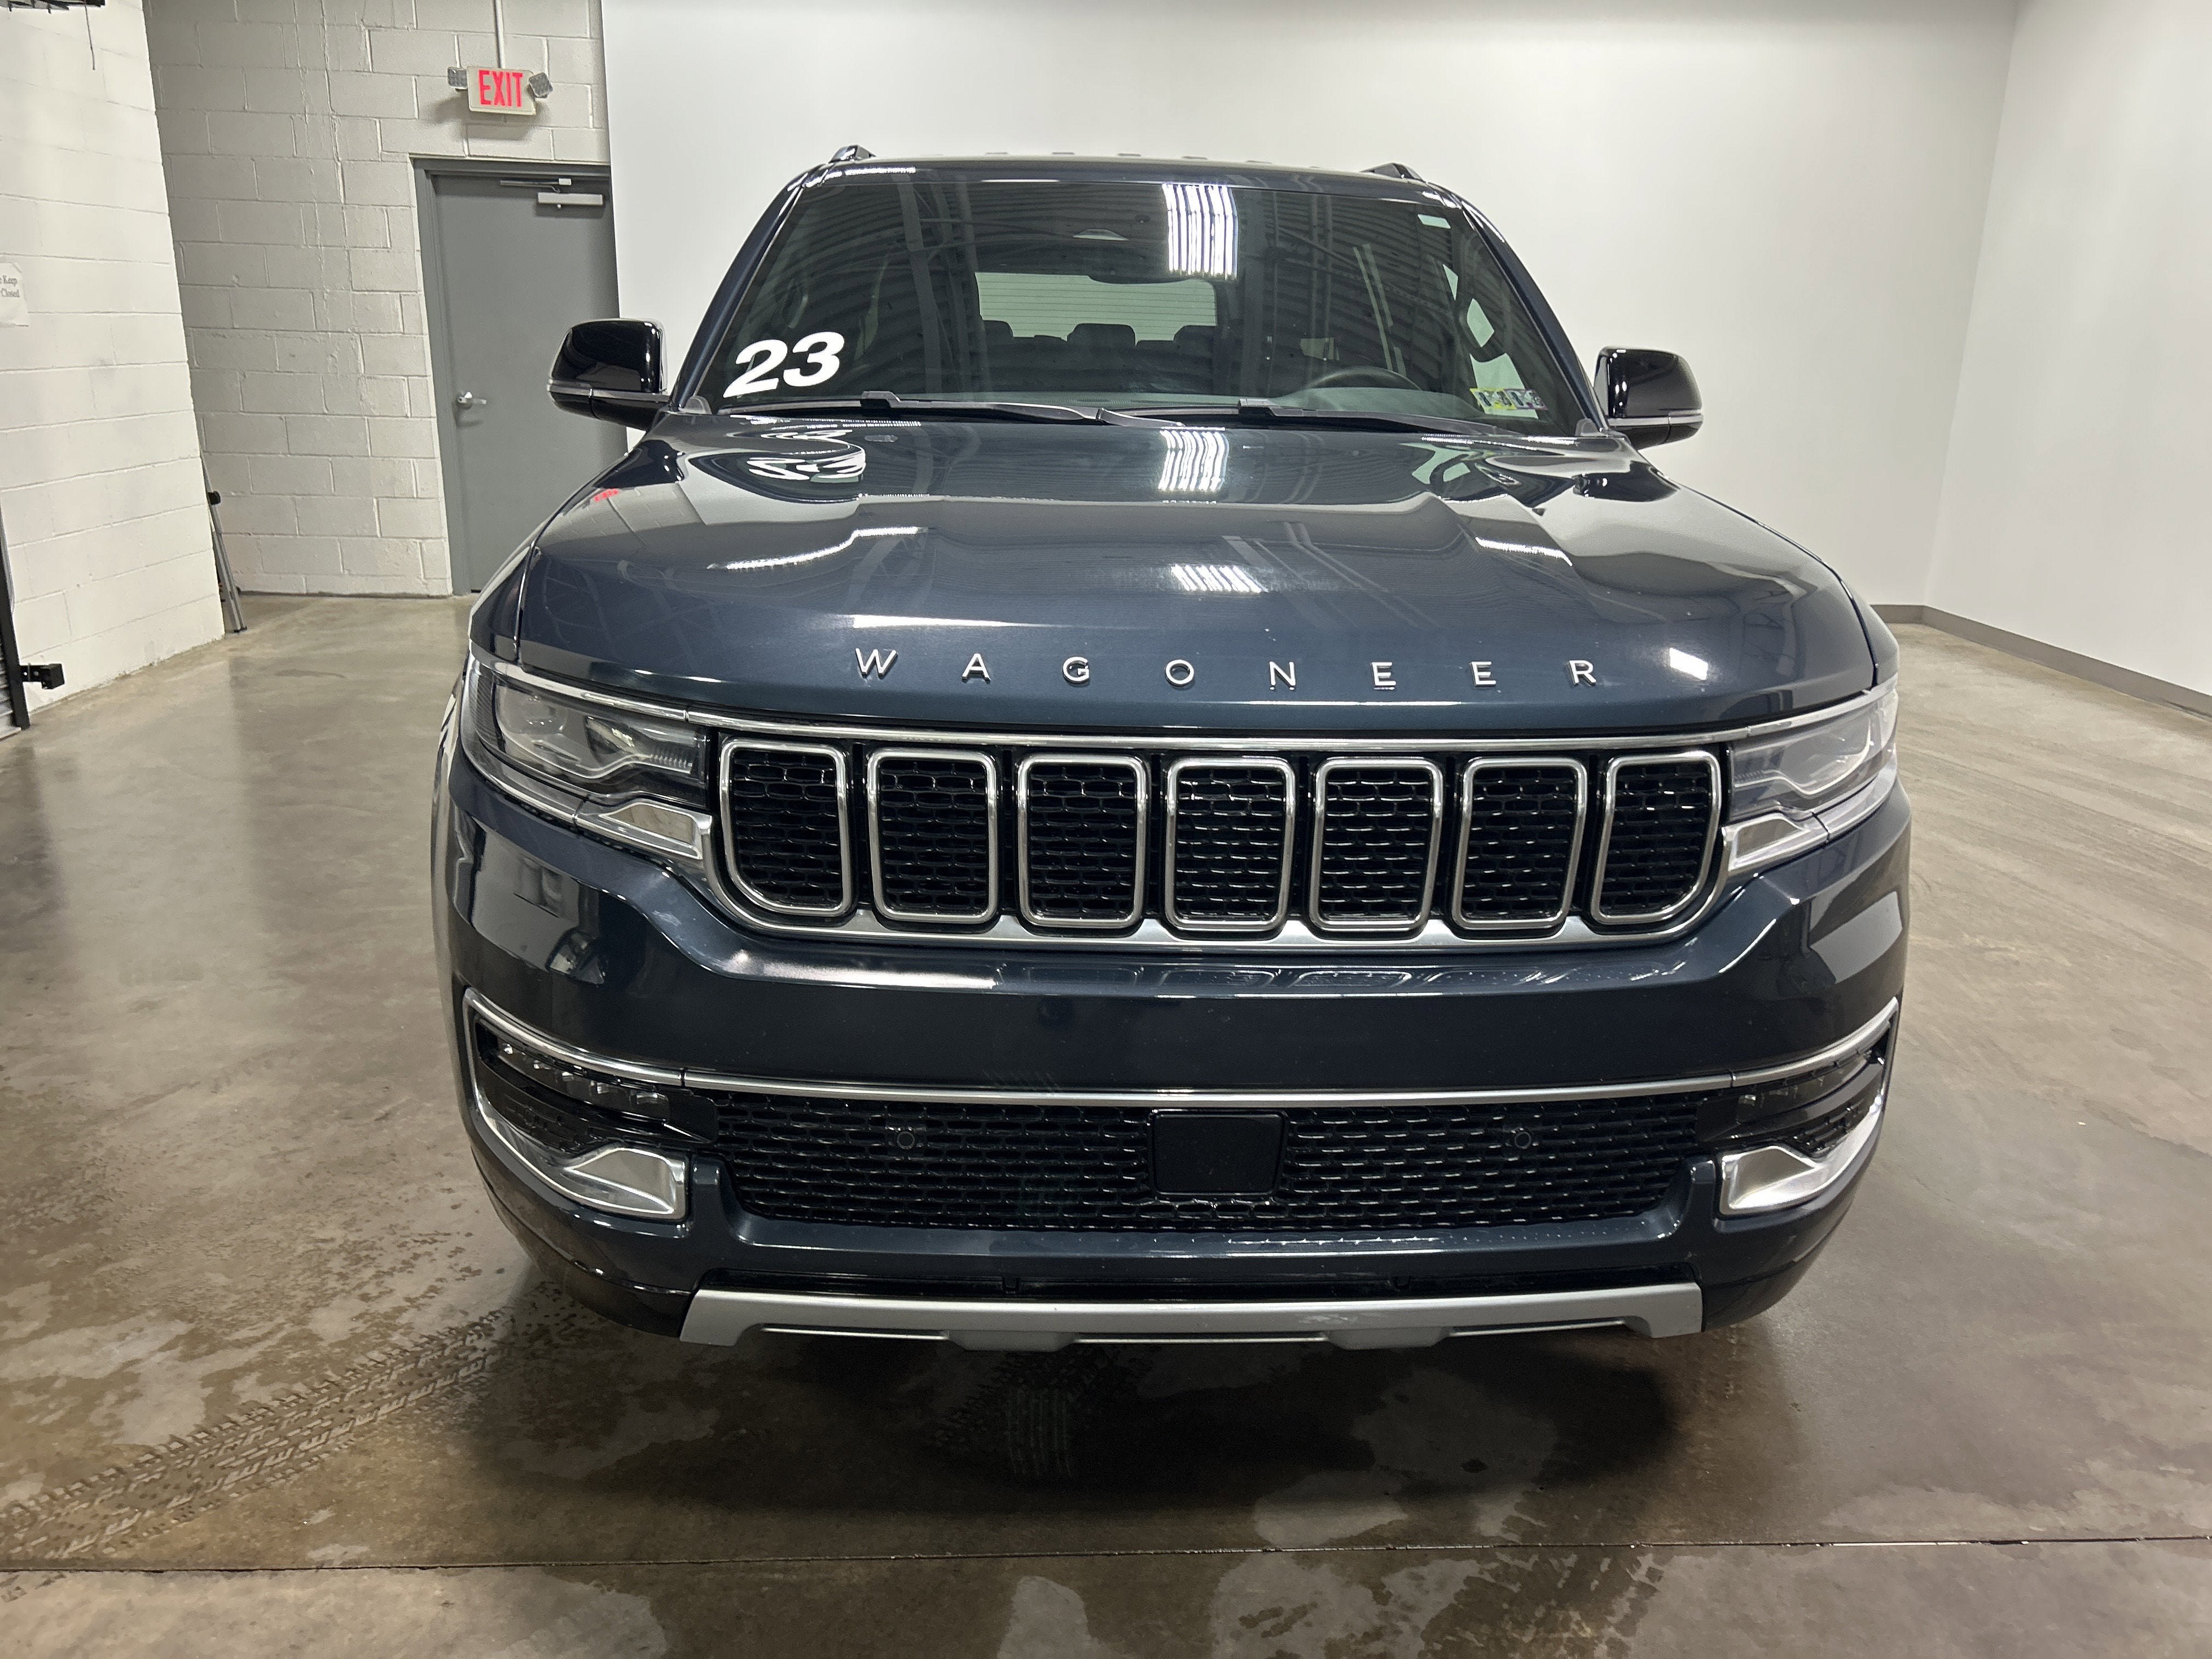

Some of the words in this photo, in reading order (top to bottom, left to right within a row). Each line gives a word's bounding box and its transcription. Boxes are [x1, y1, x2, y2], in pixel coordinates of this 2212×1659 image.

[478, 69, 523, 108] EXIT
[2, 275, 18, 287] Keep
[723, 331, 845, 398] 23
[855, 647, 1597, 687] WAGONEER
